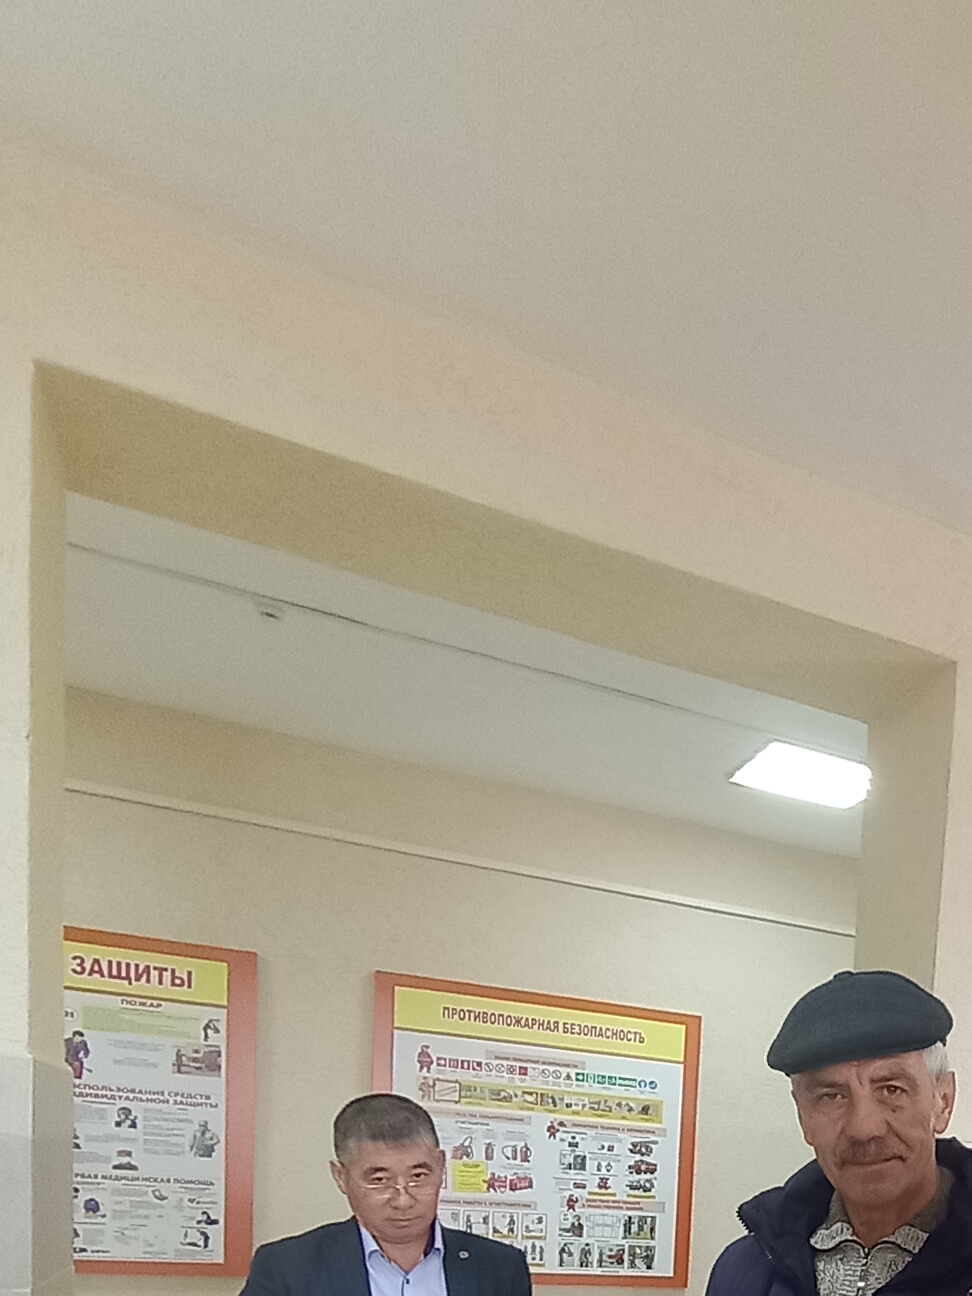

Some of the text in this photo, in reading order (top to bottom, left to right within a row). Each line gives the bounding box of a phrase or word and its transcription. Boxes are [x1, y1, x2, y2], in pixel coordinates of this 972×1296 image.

[70, 955, 193, 989] ЗАЩИТЫ
[121, 998, 163, 1009] ПОЖАР
[442, 1006, 645, 1044] ПРОТИВОПОЖАРНАЯ БЕЗОПАСНОСТЬ
[73, 1091, 170, 1105] ДИВИДУАЛЬНОЙ
[74, 1172, 99, 1180] РВАЯ
